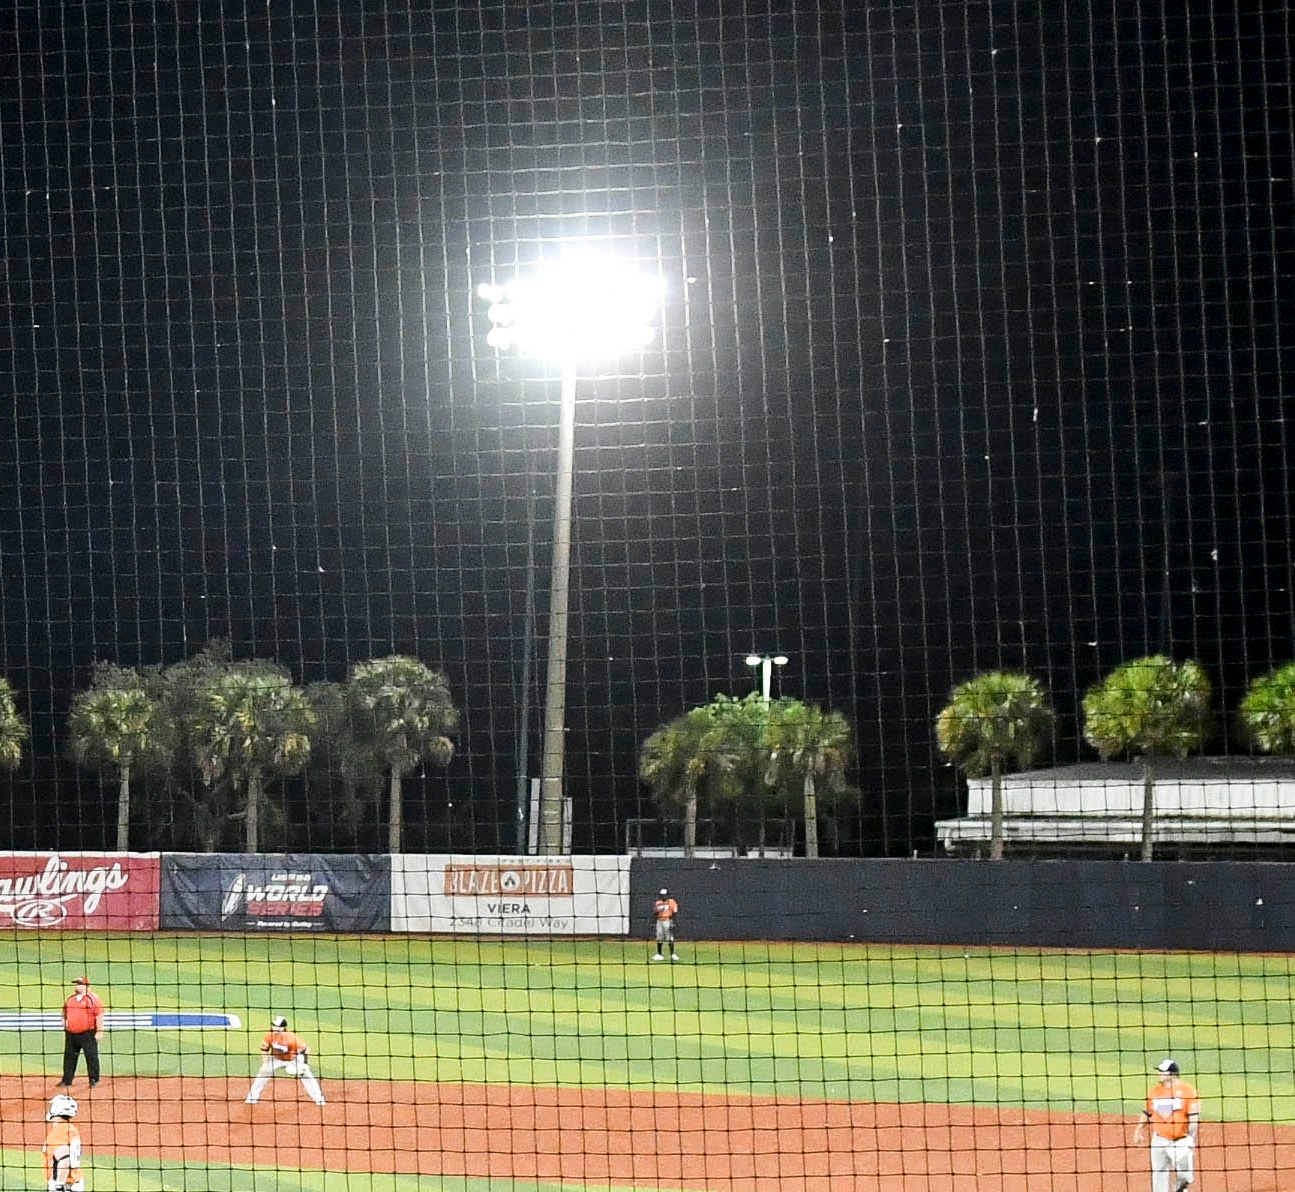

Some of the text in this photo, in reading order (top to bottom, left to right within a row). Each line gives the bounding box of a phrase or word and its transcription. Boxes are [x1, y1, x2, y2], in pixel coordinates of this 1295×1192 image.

[449, 867, 569, 893] BLAZE PIZZA
[246, 885, 328, 902] WORLD
[247, 901, 324, 916] SERIES
[487, 903, 531, 914] VIERA
[538, 917, 569, 929] Way
